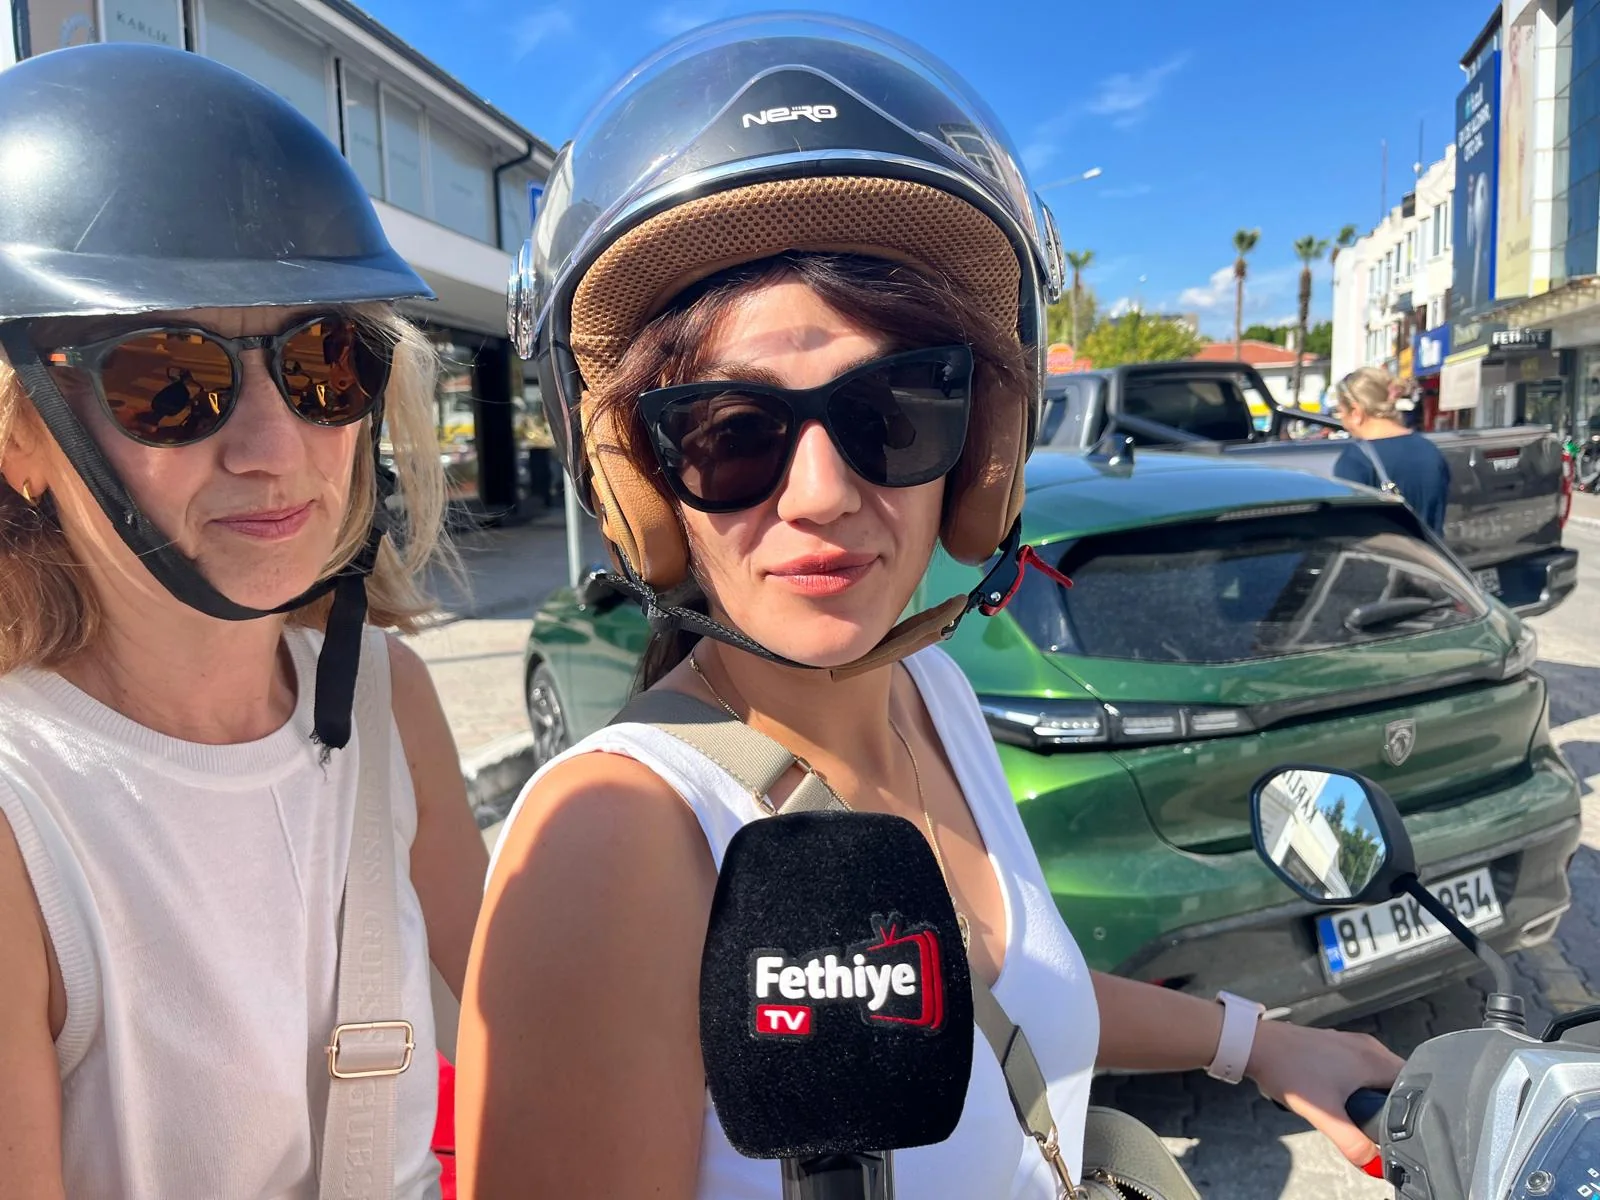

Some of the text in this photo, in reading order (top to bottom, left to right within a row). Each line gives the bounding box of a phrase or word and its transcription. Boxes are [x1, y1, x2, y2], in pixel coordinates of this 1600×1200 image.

[1338, 910, 1378, 958] 81
[1390, 897, 1430, 943] BK
[755, 953, 916, 1011] Fethiye
[763, 1009, 806, 1030] TV
[344, 1079, 376, 1200] GUES
